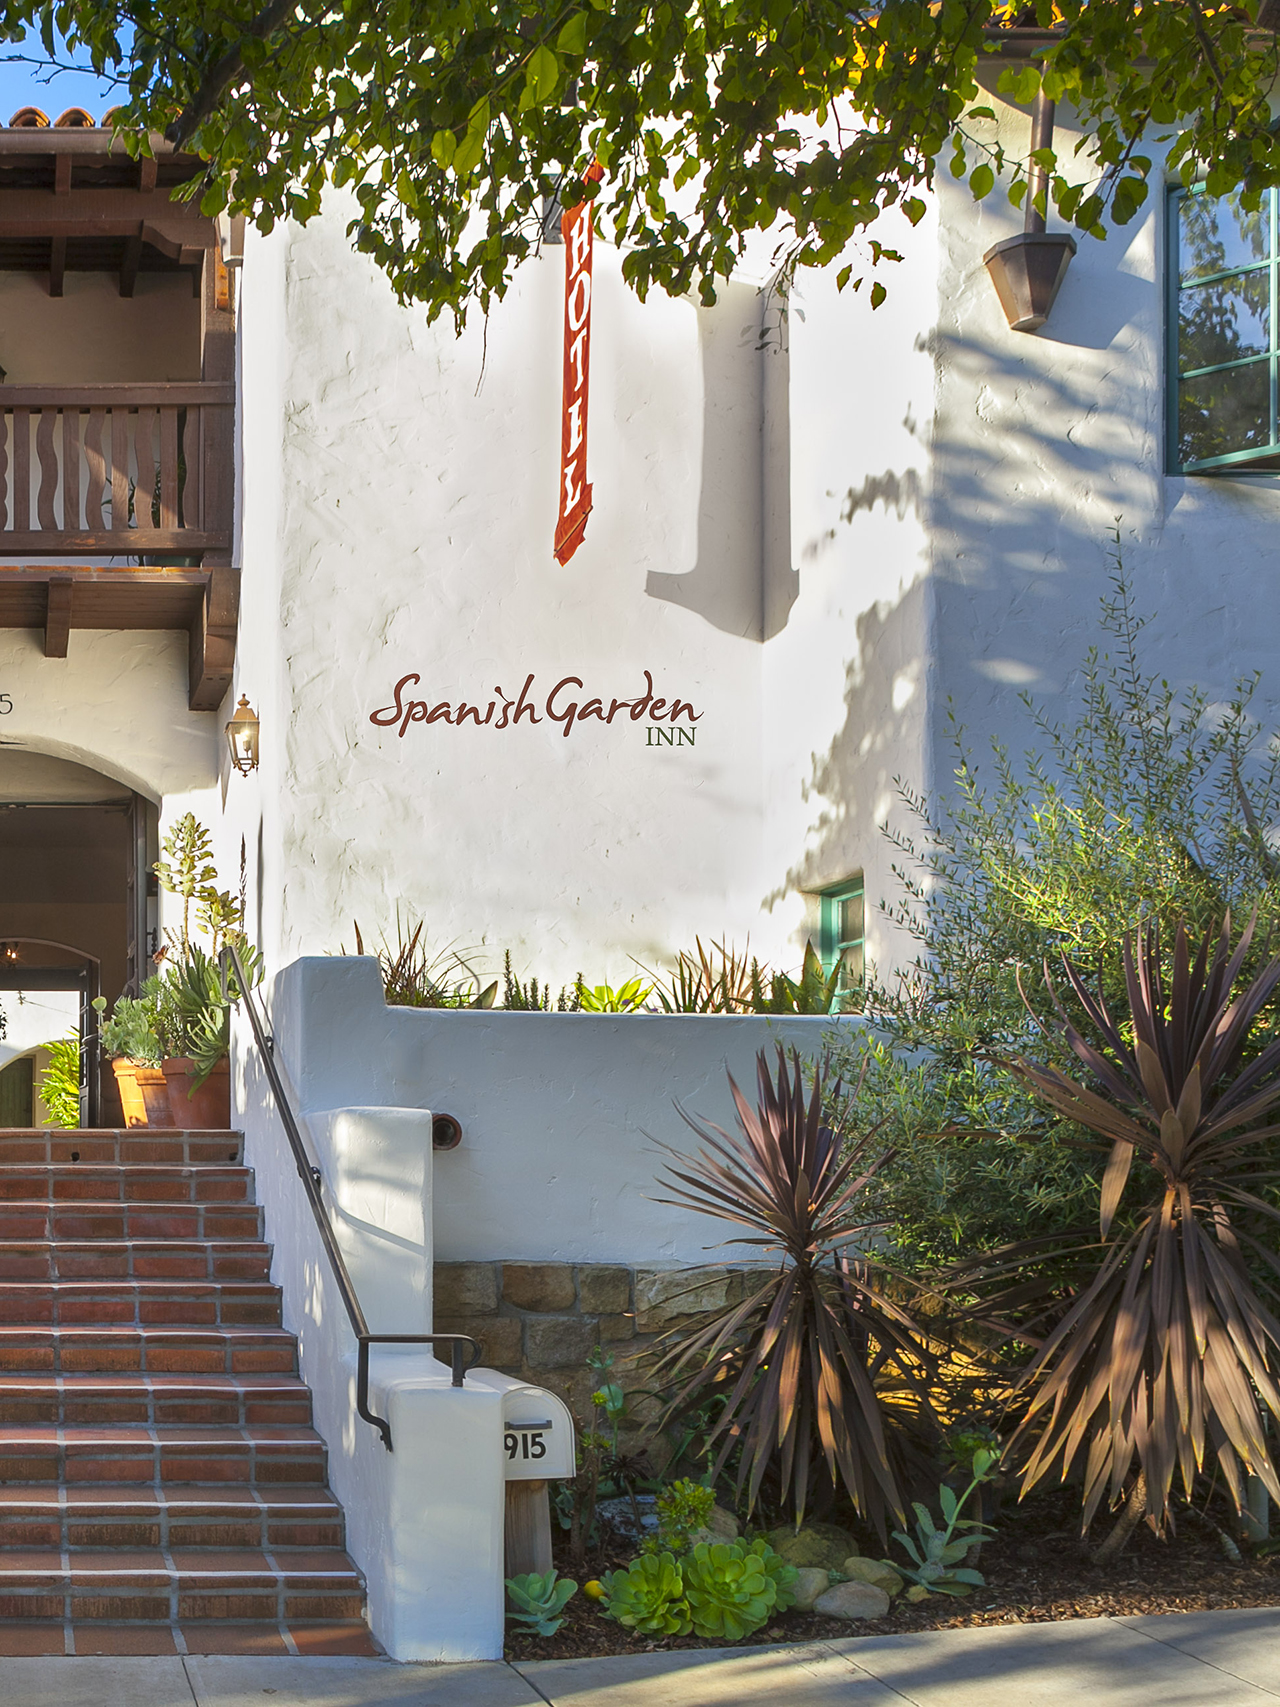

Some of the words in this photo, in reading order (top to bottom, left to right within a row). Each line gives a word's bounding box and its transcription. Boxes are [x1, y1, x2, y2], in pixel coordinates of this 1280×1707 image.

[563, 200, 592, 518] HOTEL
[369, 673, 544, 738] Spanish
[545, 670, 705, 738] Garden
[645, 726, 697, 747] INN
[503, 1432, 547, 1460] 915
